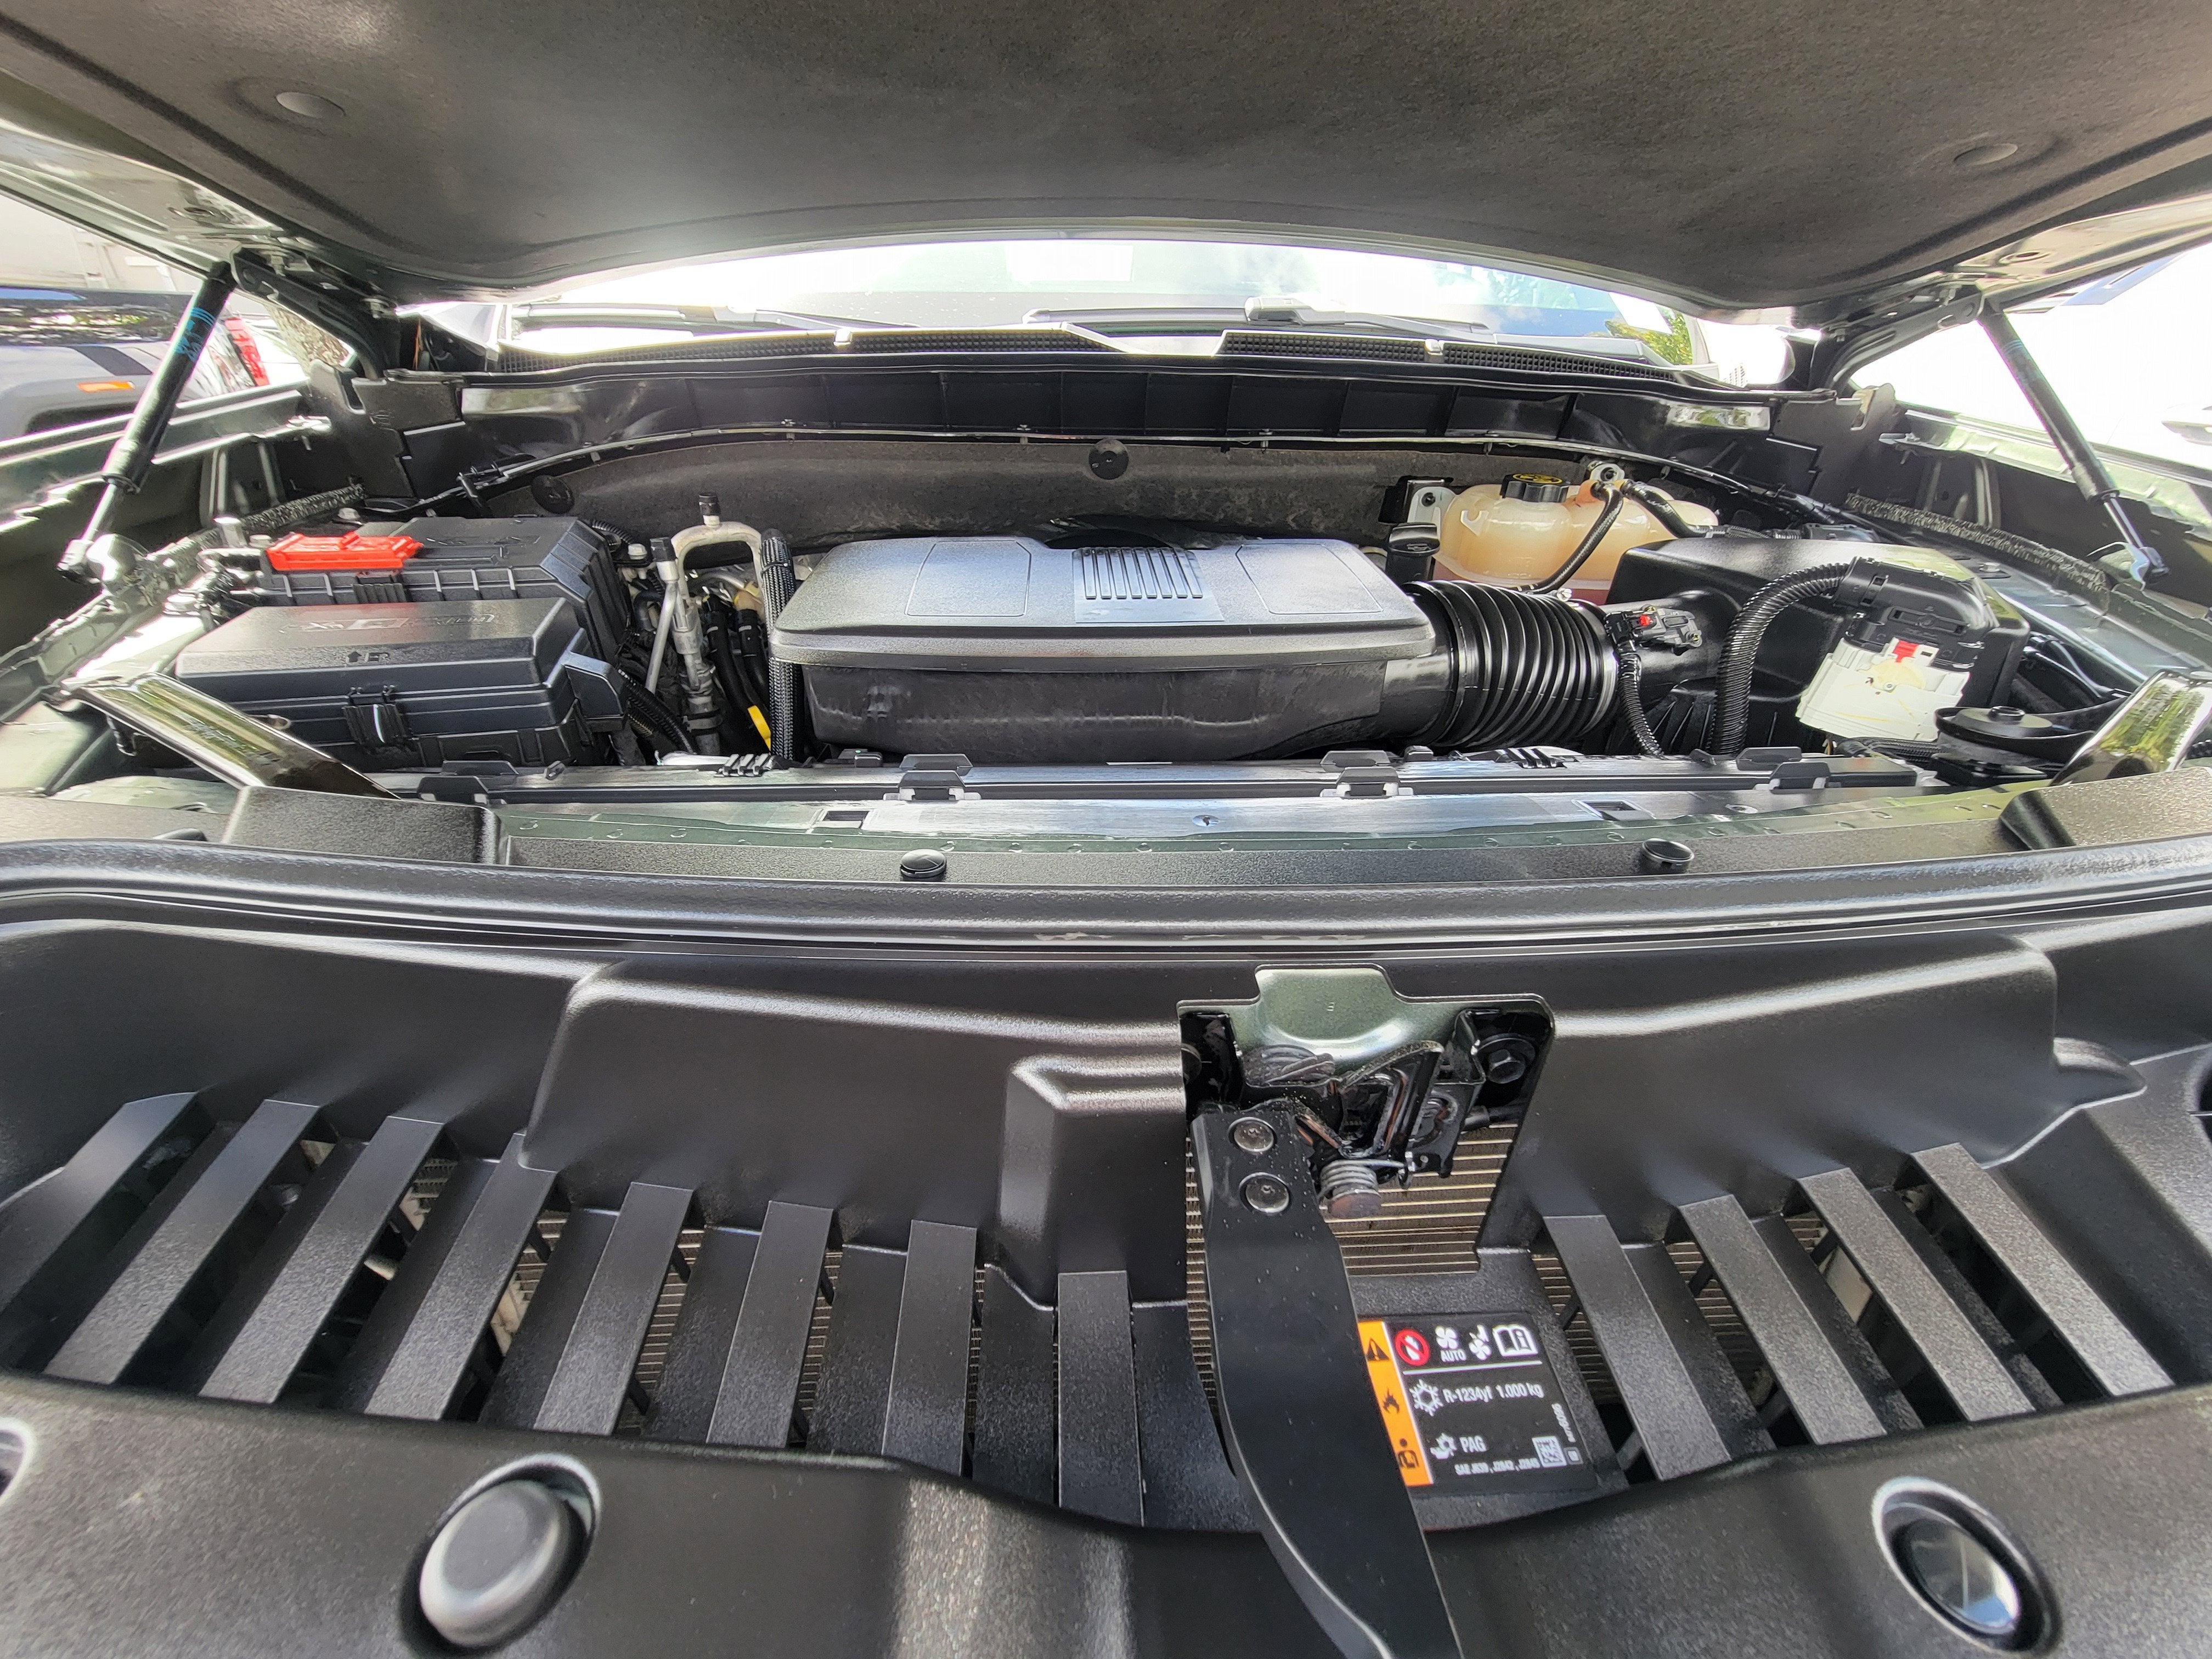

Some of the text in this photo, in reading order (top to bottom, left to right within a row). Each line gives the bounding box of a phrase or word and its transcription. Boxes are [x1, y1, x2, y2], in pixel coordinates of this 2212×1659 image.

[1440, 1349, 1467, 1362] AUTO
[1442, 1382, 1544, 1403] R-1234yf 1.000 kg
[1459, 1435, 1487, 1453] PAG
